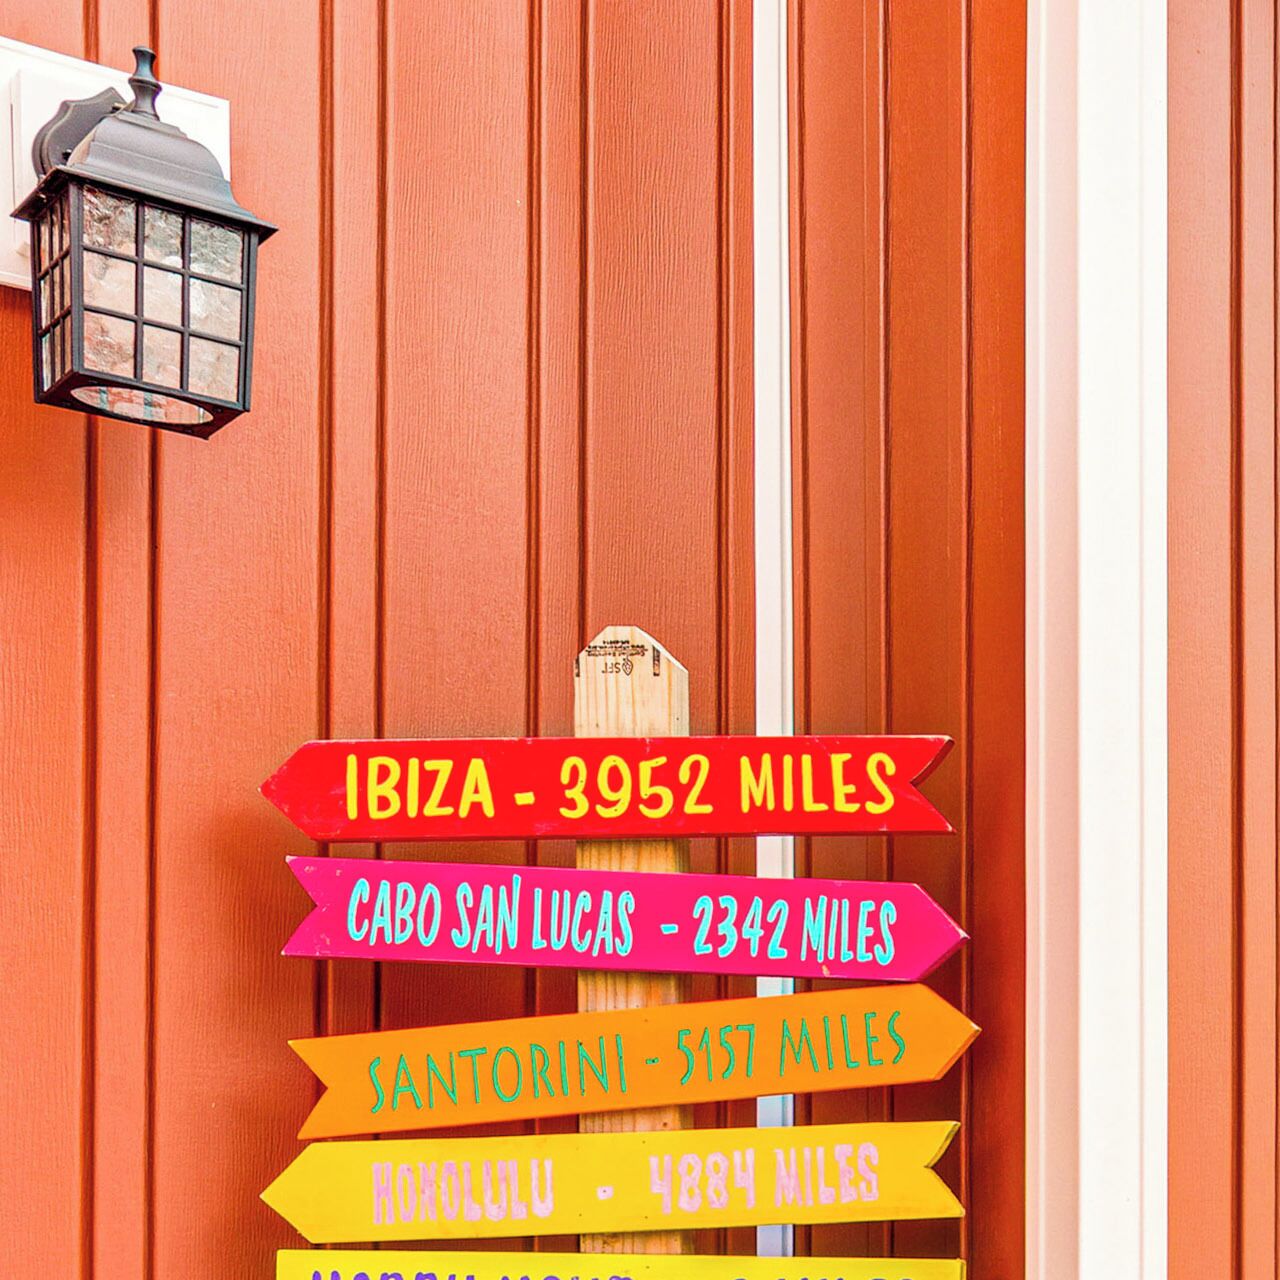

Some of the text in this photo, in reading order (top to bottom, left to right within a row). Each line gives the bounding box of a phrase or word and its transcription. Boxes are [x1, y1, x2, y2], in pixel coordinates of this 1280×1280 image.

[347, 754, 494, 819] IBIZA
[560, 754, 713, 818] 3952
[740, 753, 895, 814] MILES
[347, 878, 441, 947] CABO
[450, 873, 521, 955] SAN
[532, 888, 635, 956] LUCAS
[693, 896, 788, 959] 2342
[801, 896, 896, 965] MILES
[369, 1034, 627, 1113] SANTORINI
[677, 1024, 755, 1085] 5157
[780, 1010, 906, 1077] MILES
[372, 1158, 554, 1224] HONOLULU
[649, 1148, 755, 1215] 4884
[774, 1142, 879, 1207] MILES
